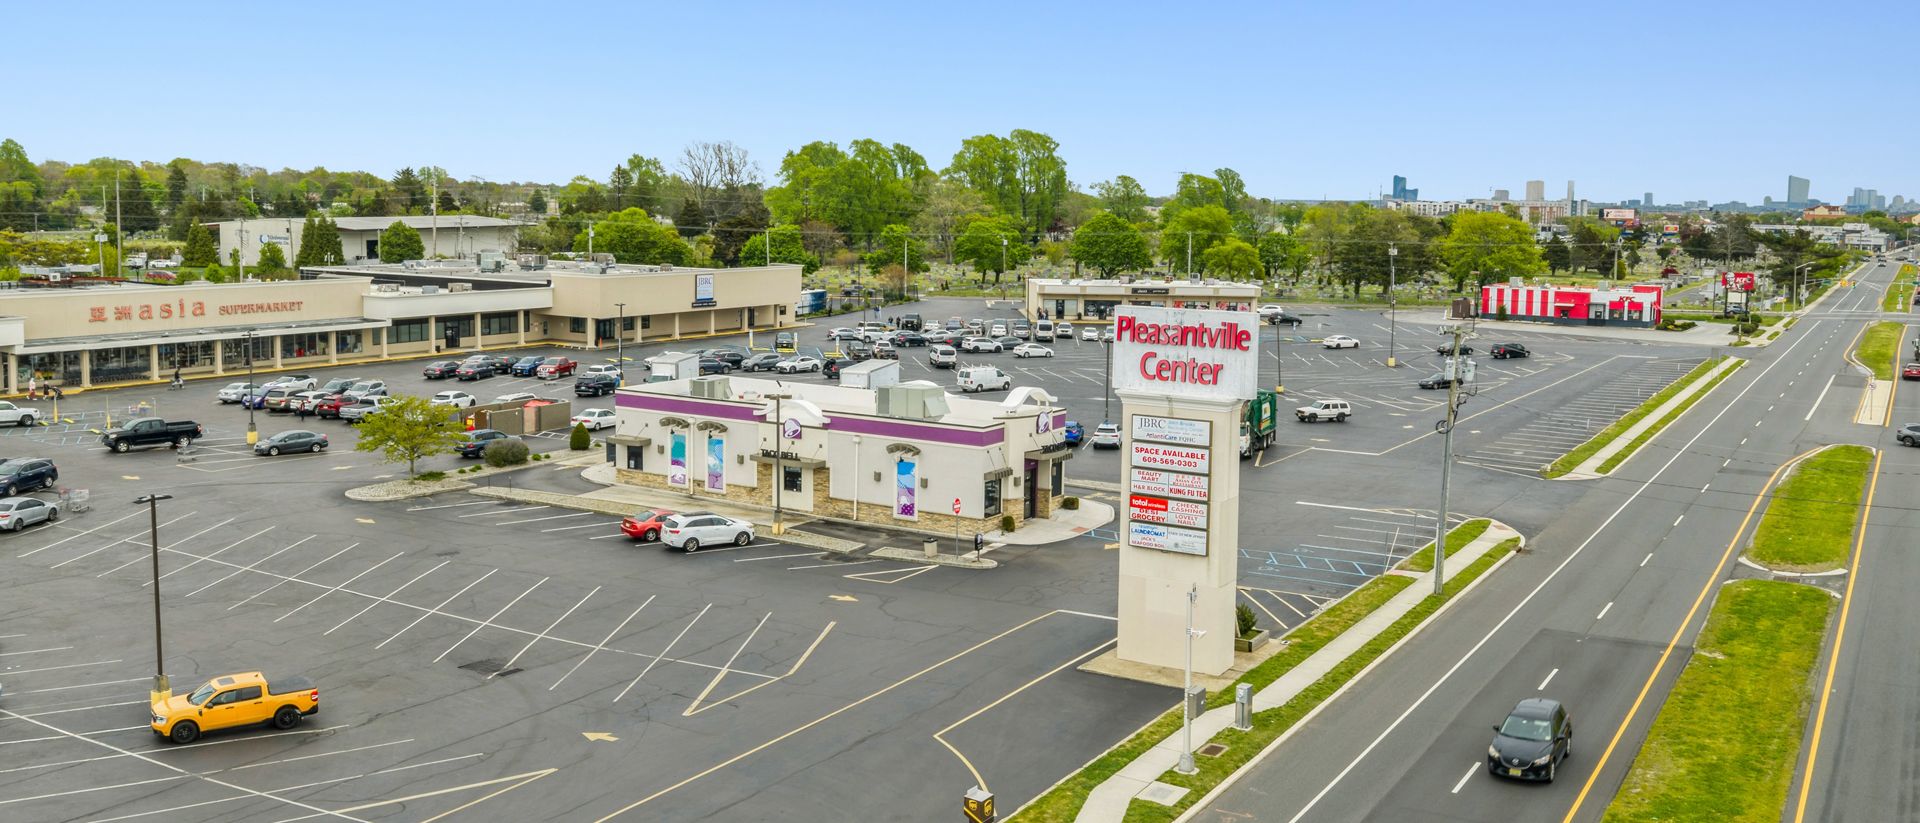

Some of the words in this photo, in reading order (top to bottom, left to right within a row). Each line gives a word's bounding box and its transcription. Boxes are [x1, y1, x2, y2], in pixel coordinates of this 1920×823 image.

[138, 298, 206, 320] asia
[218, 302, 303, 315] SUPERMARKET
[1117, 316, 1250, 351] Pleasantville
[1139, 352, 1223, 385] Center
[1138, 418, 1166, 429] JBRC
[781, 451, 799, 460] BELL
[1135, 447, 1160, 455] SPACE
[1162, 449, 1205, 460] AVAILABLE
[1142, 456, 1197, 467] 609-569-0303
[1131, 513, 1165, 522] GROCERY
[1131, 528, 1165, 536] LAUNDROMAT
